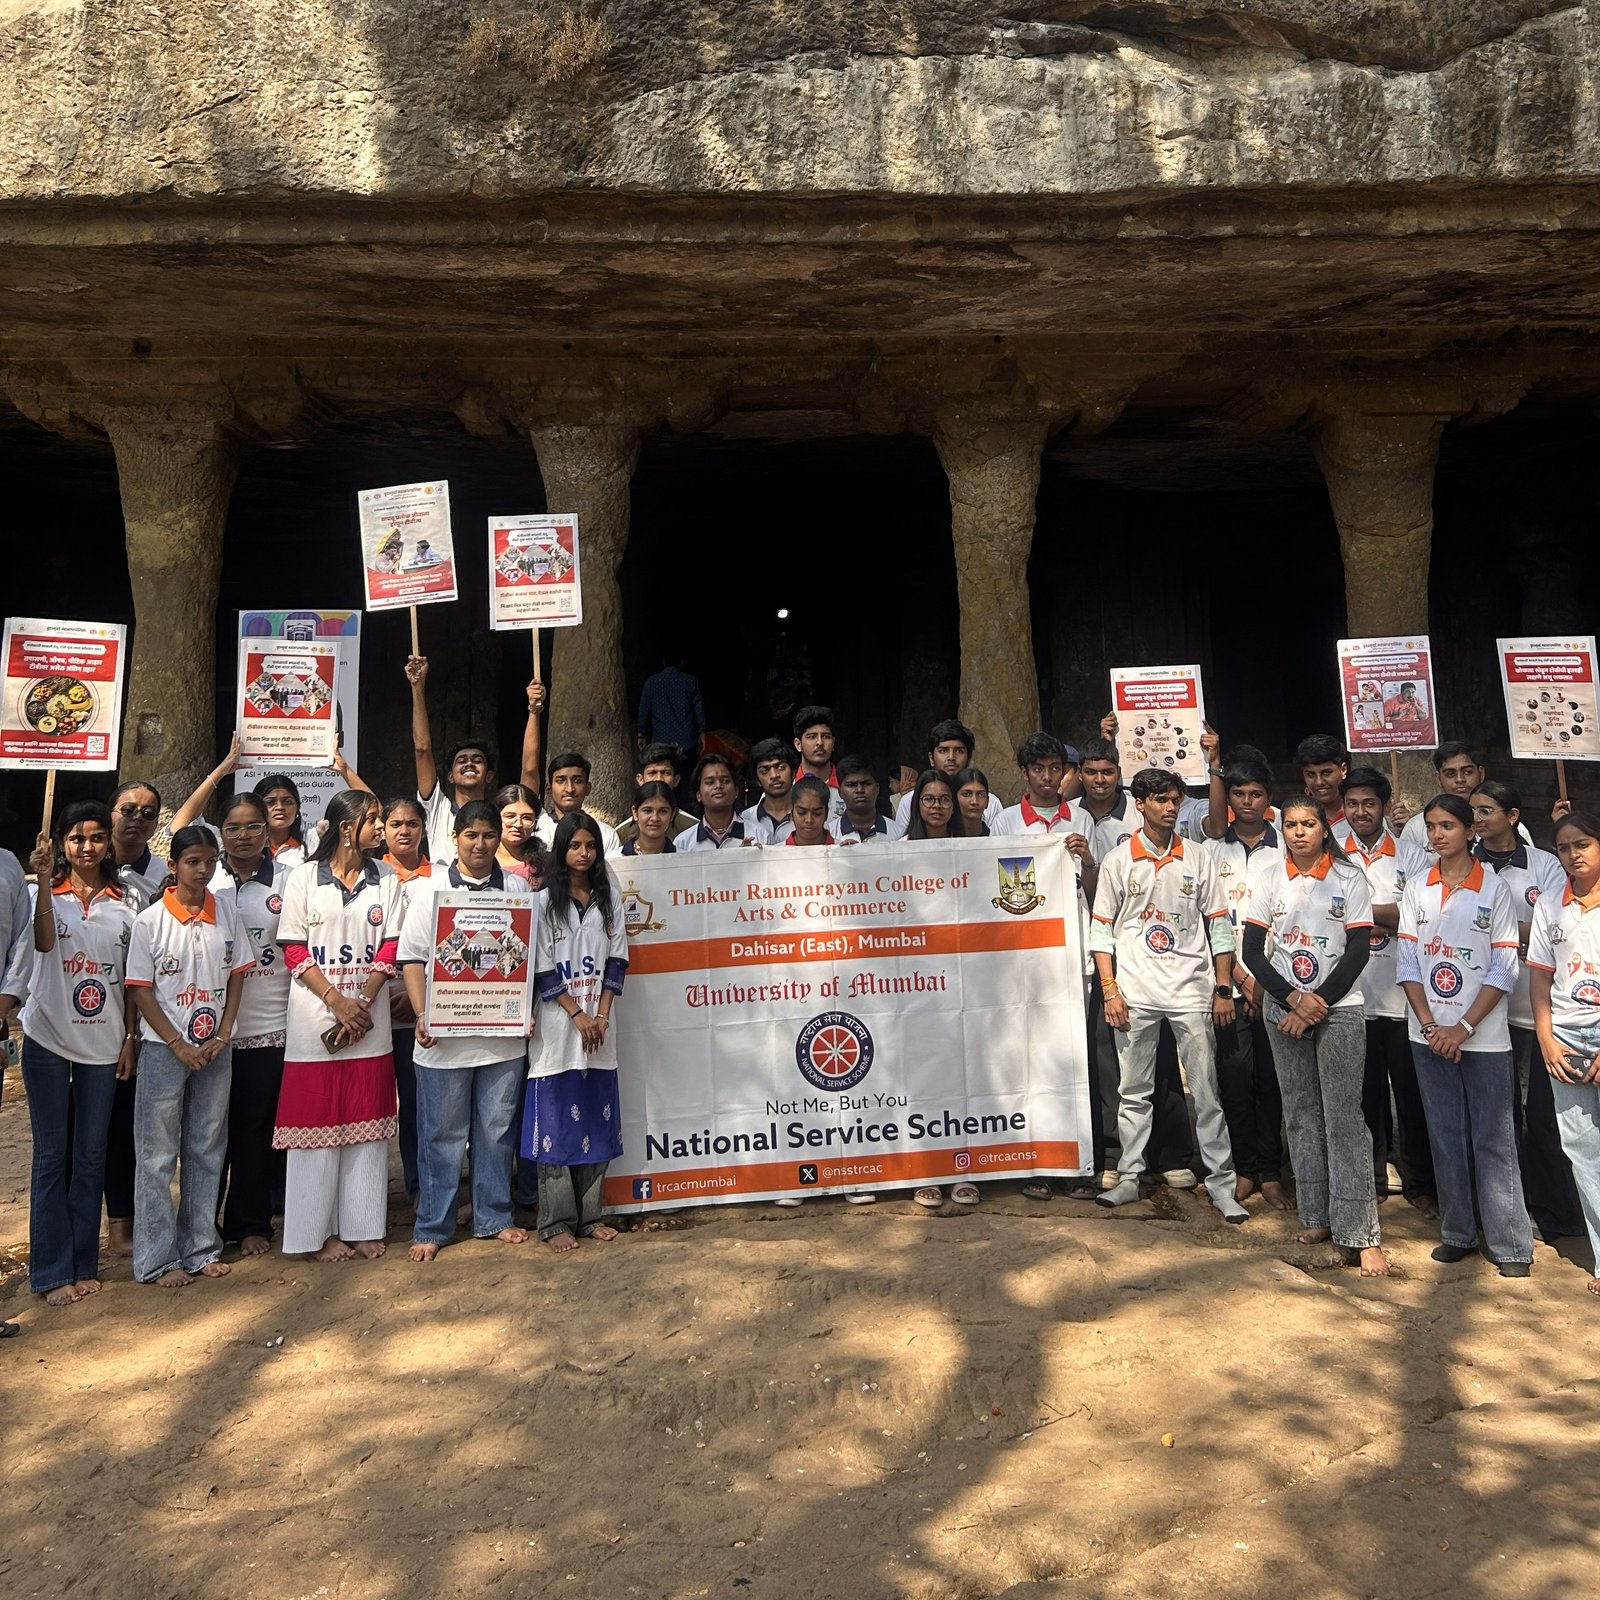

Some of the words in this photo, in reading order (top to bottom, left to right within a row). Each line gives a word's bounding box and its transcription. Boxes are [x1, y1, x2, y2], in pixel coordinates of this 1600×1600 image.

[311, 780, 335, 789] Guide
[668, 887, 741, 906] Thakur
[747, 881, 869, 900] Ramnarayan
[875, 874, 945, 894] College
[950, 871, 970, 889] of
[733, 905, 775, 922] Arts
[780, 902, 798, 919] &
[804, 900, 907, 918] Commerce
[731, 940, 796, 958] Dahisar
[800, 936, 854, 957] (East),
[858, 931, 927, 949] Mumbai
[243, 971, 255, 979] UT
[258, 969, 274, 977] YOU
[329, 967, 341, 976] ME
[342, 967, 359, 976] BUT
[361, 967, 372, 975] YO
[685, 979, 812, 1008] University
[819, 975, 840, 998] of
[847, 969, 947, 998] Mumbai
[801, 1057, 826, 1087] NATIONAL
[826, 1075, 854, 1088] SERVICE
[851, 1054, 871, 1081] SCHEME
[766, 1099, 798, 1116] Not
[803, 1097, 834, 1114] Me,
[840, 1095, 869, 1110] But
[873, 1093, 908, 1108] You
[646, 1122, 778, 1161] National
[786, 1117, 899, 1149] Service
[907, 1110, 1026, 1140] Scheme
[978, 1150, 1038, 1165] @trcacnss
[822, 1163, 883, 1179] @nsstrcac
[656, 1174, 737, 1193] trcacmumbai
